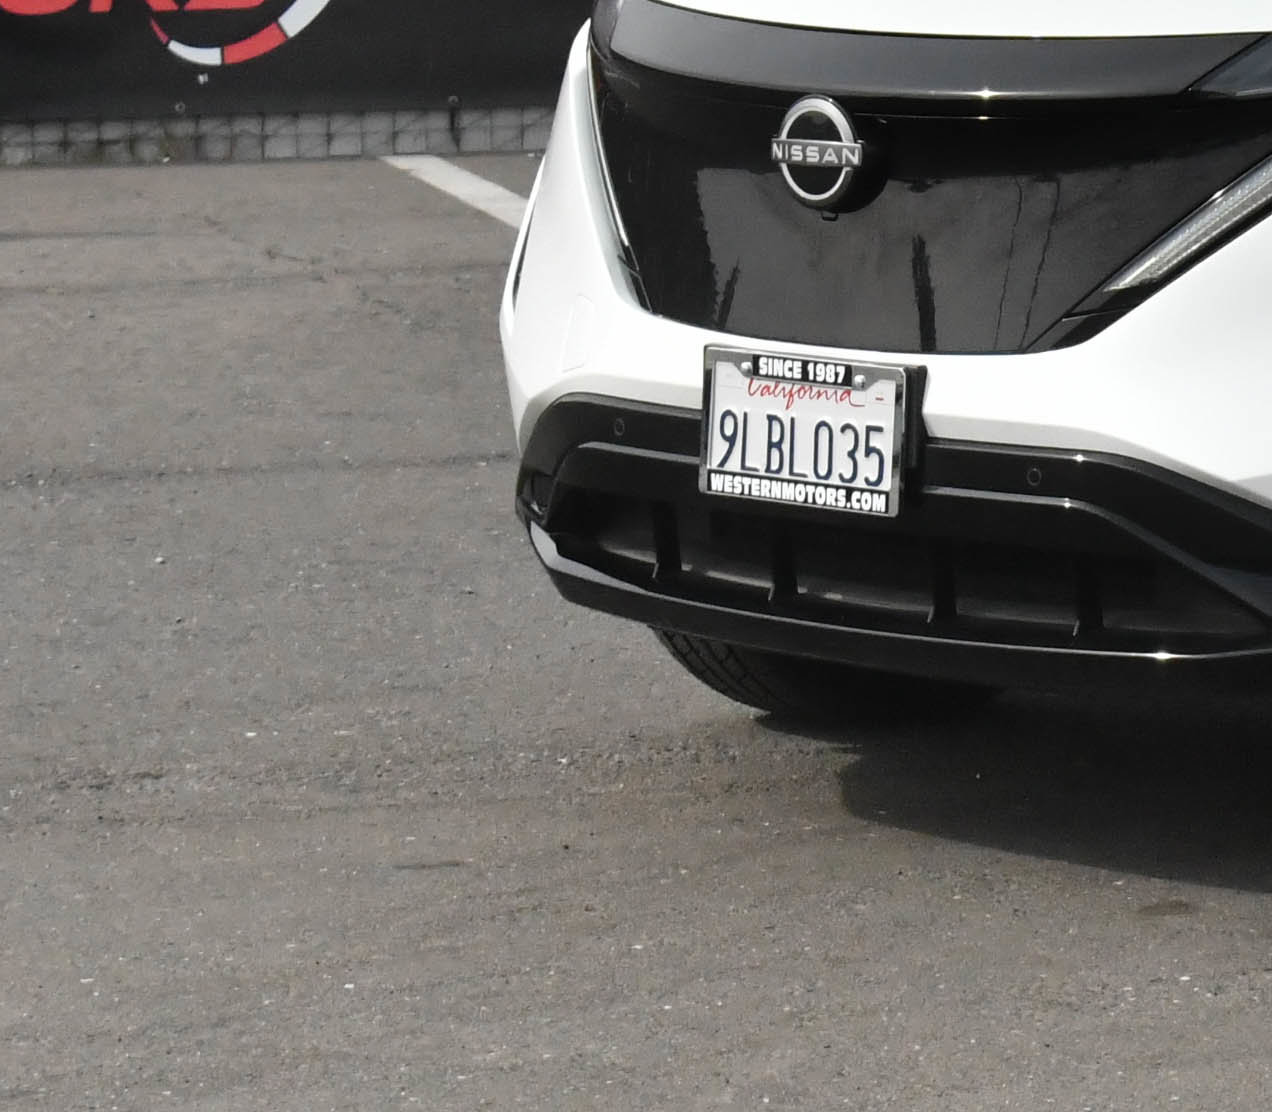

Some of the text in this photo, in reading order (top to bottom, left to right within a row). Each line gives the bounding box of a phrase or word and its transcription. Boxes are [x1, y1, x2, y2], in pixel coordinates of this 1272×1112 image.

[771, 141, 860, 165] NISSAN
[759, 356, 846, 384] SINCE 1987
[717, 409, 885, 487] 9LBL035
[710, 473, 887, 513] WESTERNMOTORS.COM
